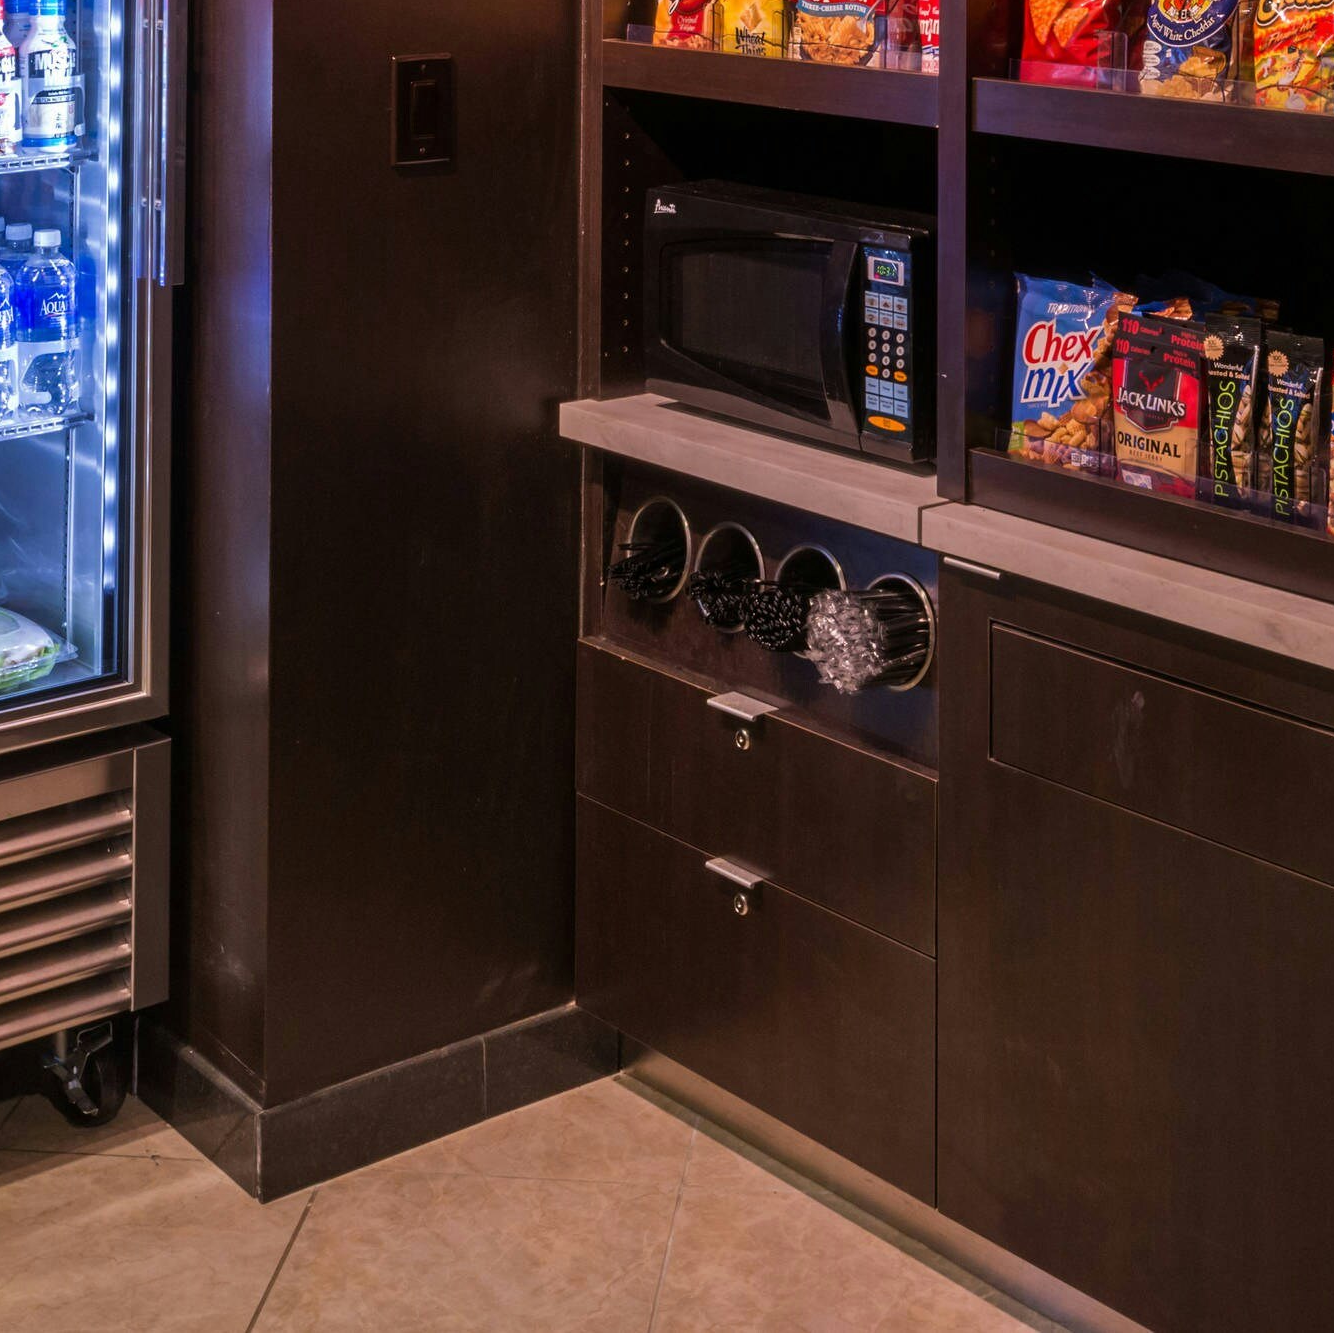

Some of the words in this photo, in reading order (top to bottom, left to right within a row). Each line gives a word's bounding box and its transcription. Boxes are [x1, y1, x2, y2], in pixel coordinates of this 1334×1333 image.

[801, 0, 843, 13] THREE-CHEESE
[735, 25, 766, 45] Wheat
[1184, 16, 1217, 42] Cheddar
[1122, 318, 1140, 335] 110
[1024, 323, 1100, 364] Chex
[1115, 338, 1130, 354] 110
[1163, 352, 1197, 369] Protein
[1118, 387, 1146, 410] JACK
[1146, 394, 1186, 417] LINK'S
[1118, 431, 1182, 459] ORIGINAL
[1214, 380, 1236, 498] PISTACHIOS
[1272, 397, 1295, 517] PISTACHIOS
